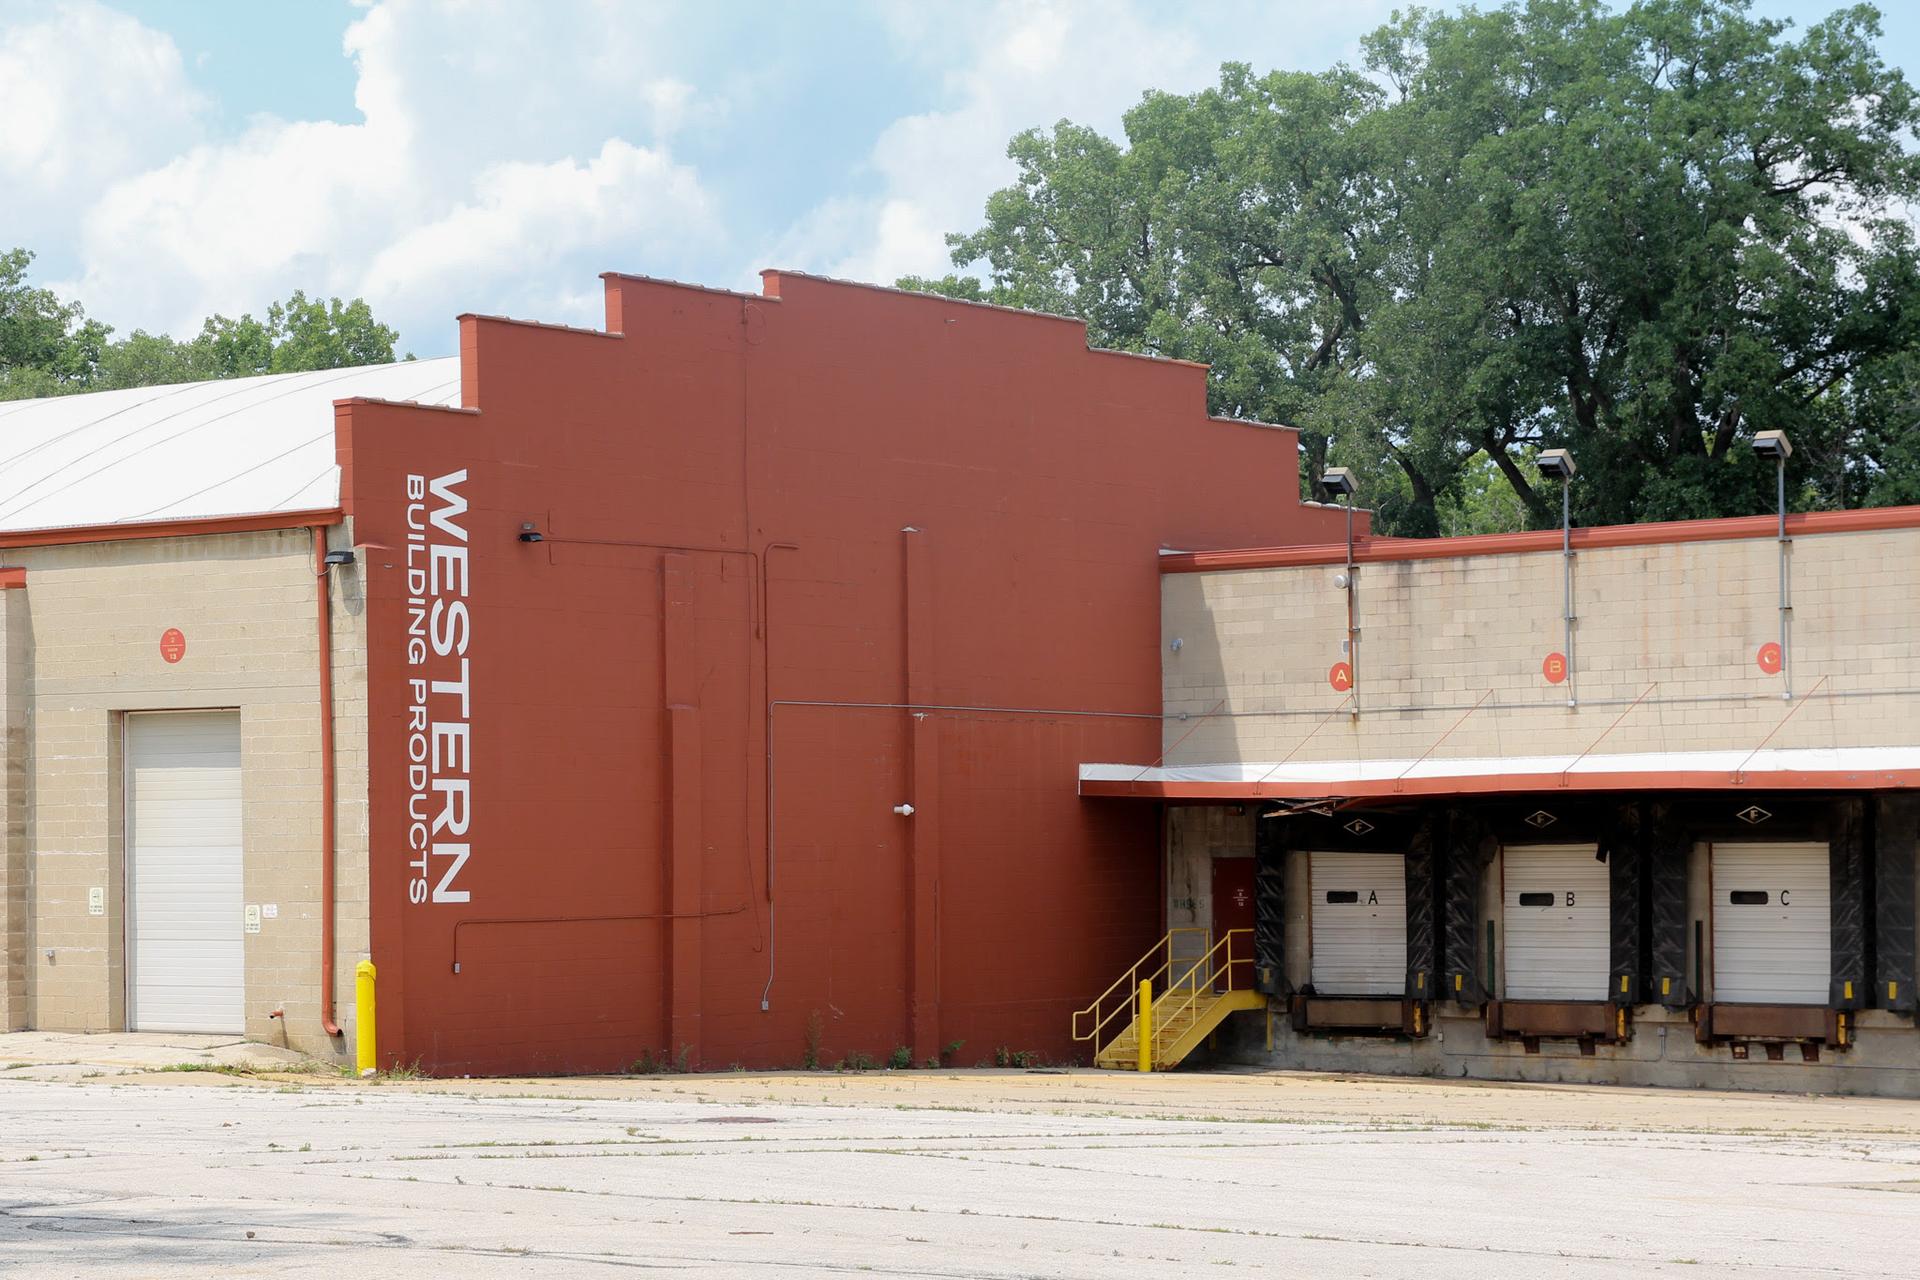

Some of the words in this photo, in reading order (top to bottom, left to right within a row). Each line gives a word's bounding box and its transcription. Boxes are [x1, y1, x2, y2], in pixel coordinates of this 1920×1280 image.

[407, 474, 427, 665] BUILDING
[1764, 650, 1777, 665] C
[1550, 660, 1561, 673] B
[1335, 669, 1348, 682] A
[429, 469, 471, 903] WESTERN
[409, 679, 428, 905] PRODUCTS
[1368, 890, 1378, 905] A
[1566, 892, 1575, 907] B
[1781, 890, 1790, 906] C
